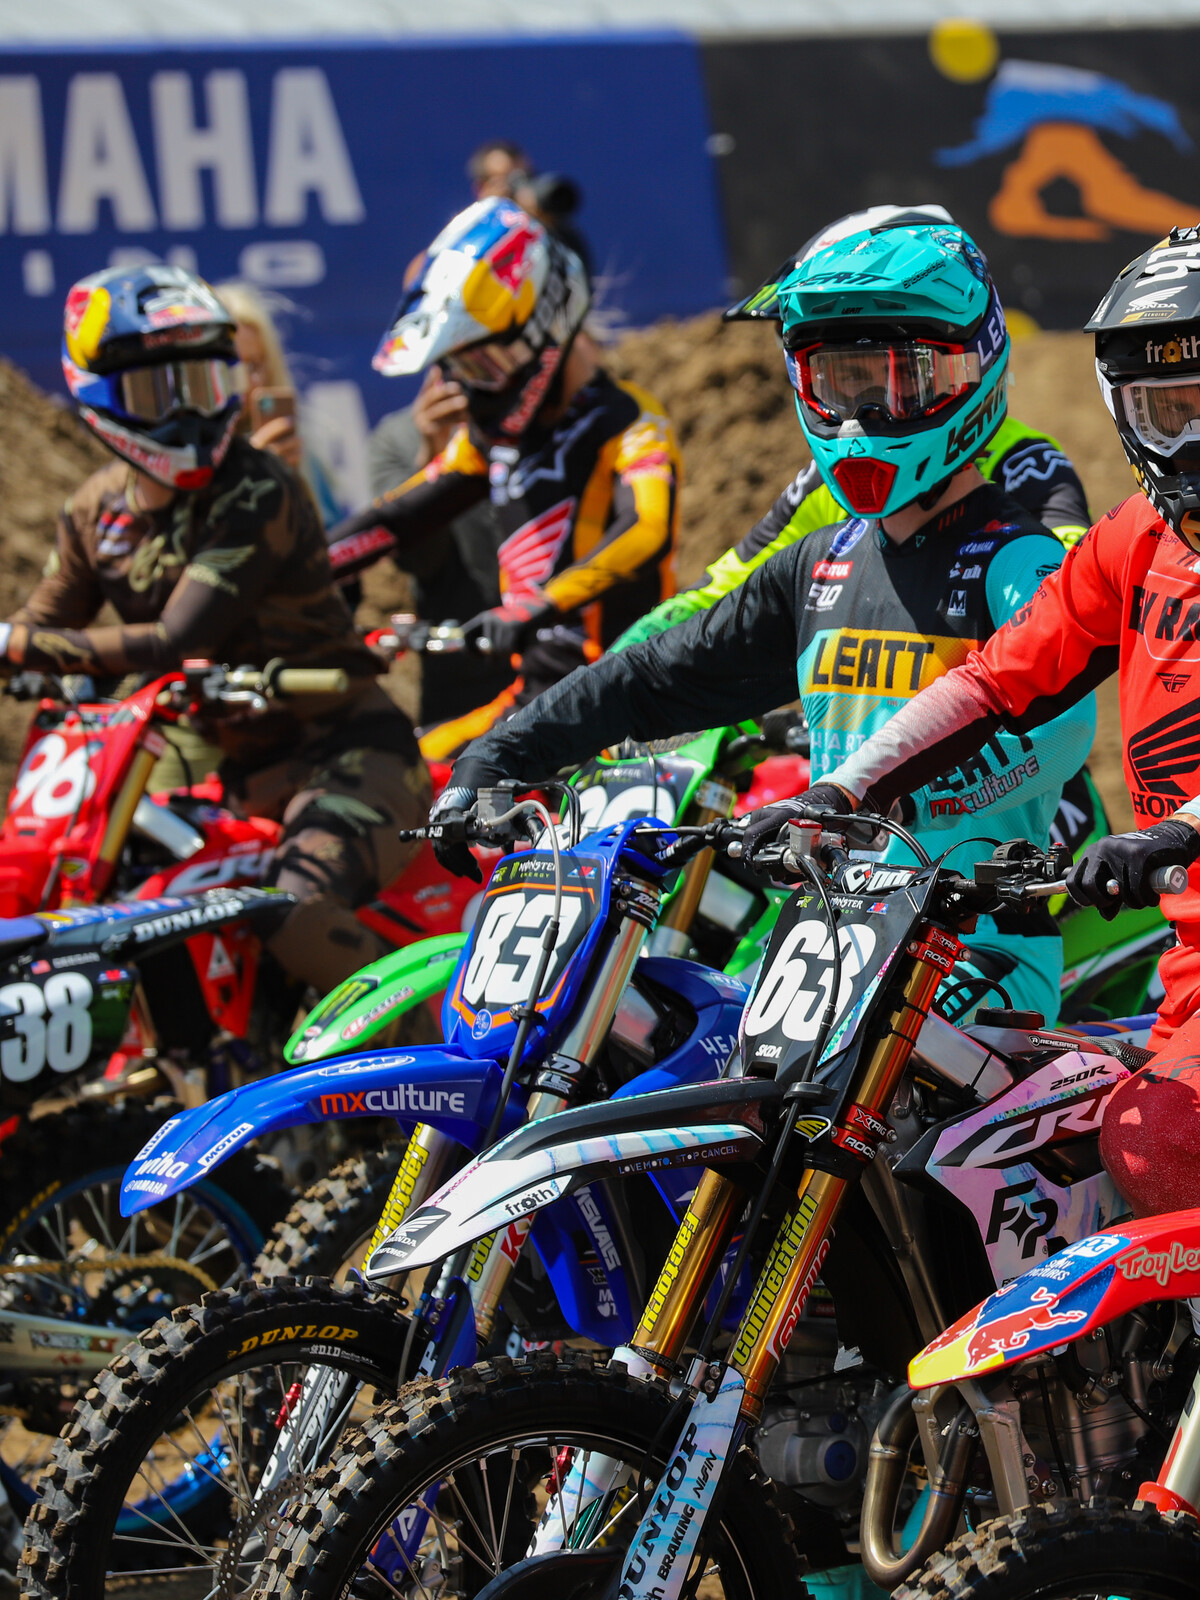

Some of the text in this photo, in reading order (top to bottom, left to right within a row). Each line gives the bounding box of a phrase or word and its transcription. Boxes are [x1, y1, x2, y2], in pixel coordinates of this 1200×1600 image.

[1125, 303, 1179, 314] HONDA
[812, 637, 934, 690] LEATT
[930, 755, 1040, 819] mxculture
[1131, 790, 1191, 818] HON
[133, 898, 244, 944] DUNLOP
[462, 892, 583, 1006] 83
[931, 930, 958, 952] XTRIG
[924, 949, 951, 967] ROCS
[745, 919, 877, 1042] 63
[0, 971, 93, 1083] 38
[755, 1043, 781, 1058] SKDA
[1050, 1064, 1112, 1092] 250R
[320, 1083, 465, 1114] mxculture
[856, 1107, 888, 1137] XTRIG
[204, 1124, 252, 1163] MOTUL
[845, 1136, 876, 1159] ROCS
[131, 1180, 168, 1196] YAMAHA
[504, 1187, 555, 1217] froth
[732, 1193, 819, 1366] connection
[1116, 1246, 1171, 1287] Troy
[239, 1325, 359, 1355] DUNLOP
[657, 1503, 696, 1581] BRAKING
